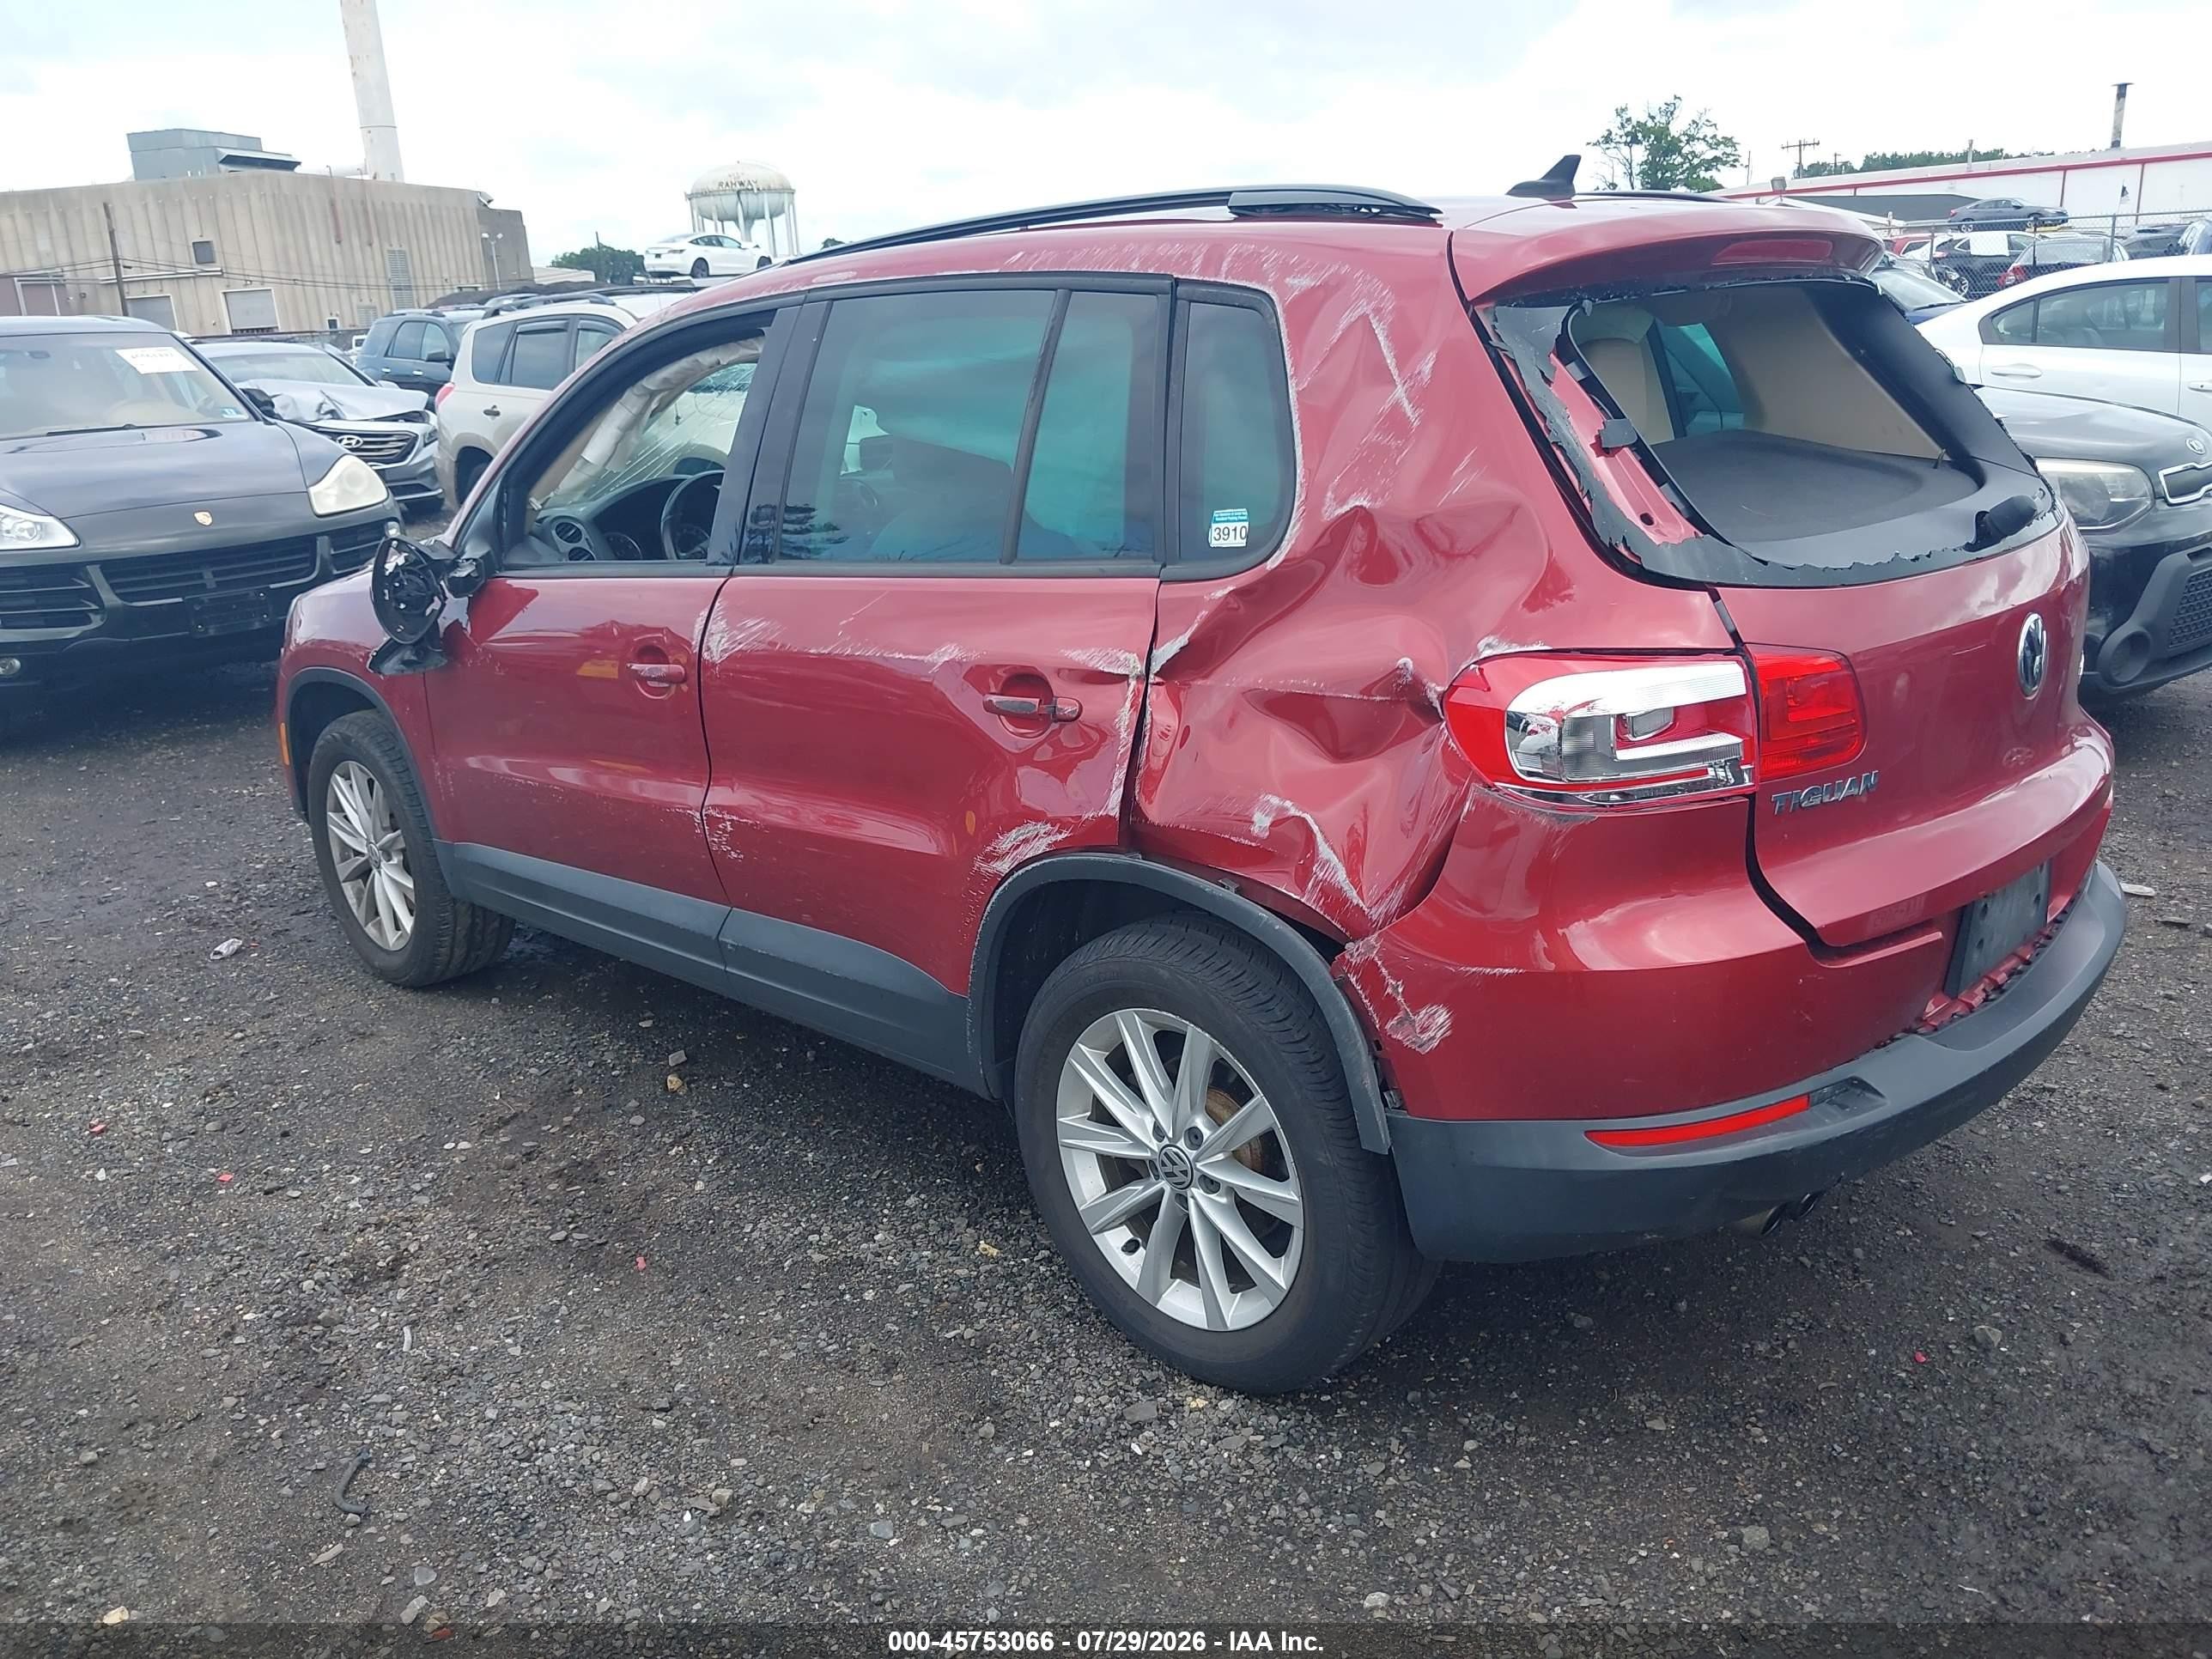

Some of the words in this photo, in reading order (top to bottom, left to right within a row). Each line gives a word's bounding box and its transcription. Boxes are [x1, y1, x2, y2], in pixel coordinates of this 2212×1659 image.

[718, 179, 757, 189] RAHWAY
[1213, 526, 1248, 541] 3910
[1771, 770, 1879, 815] TIGUAN
